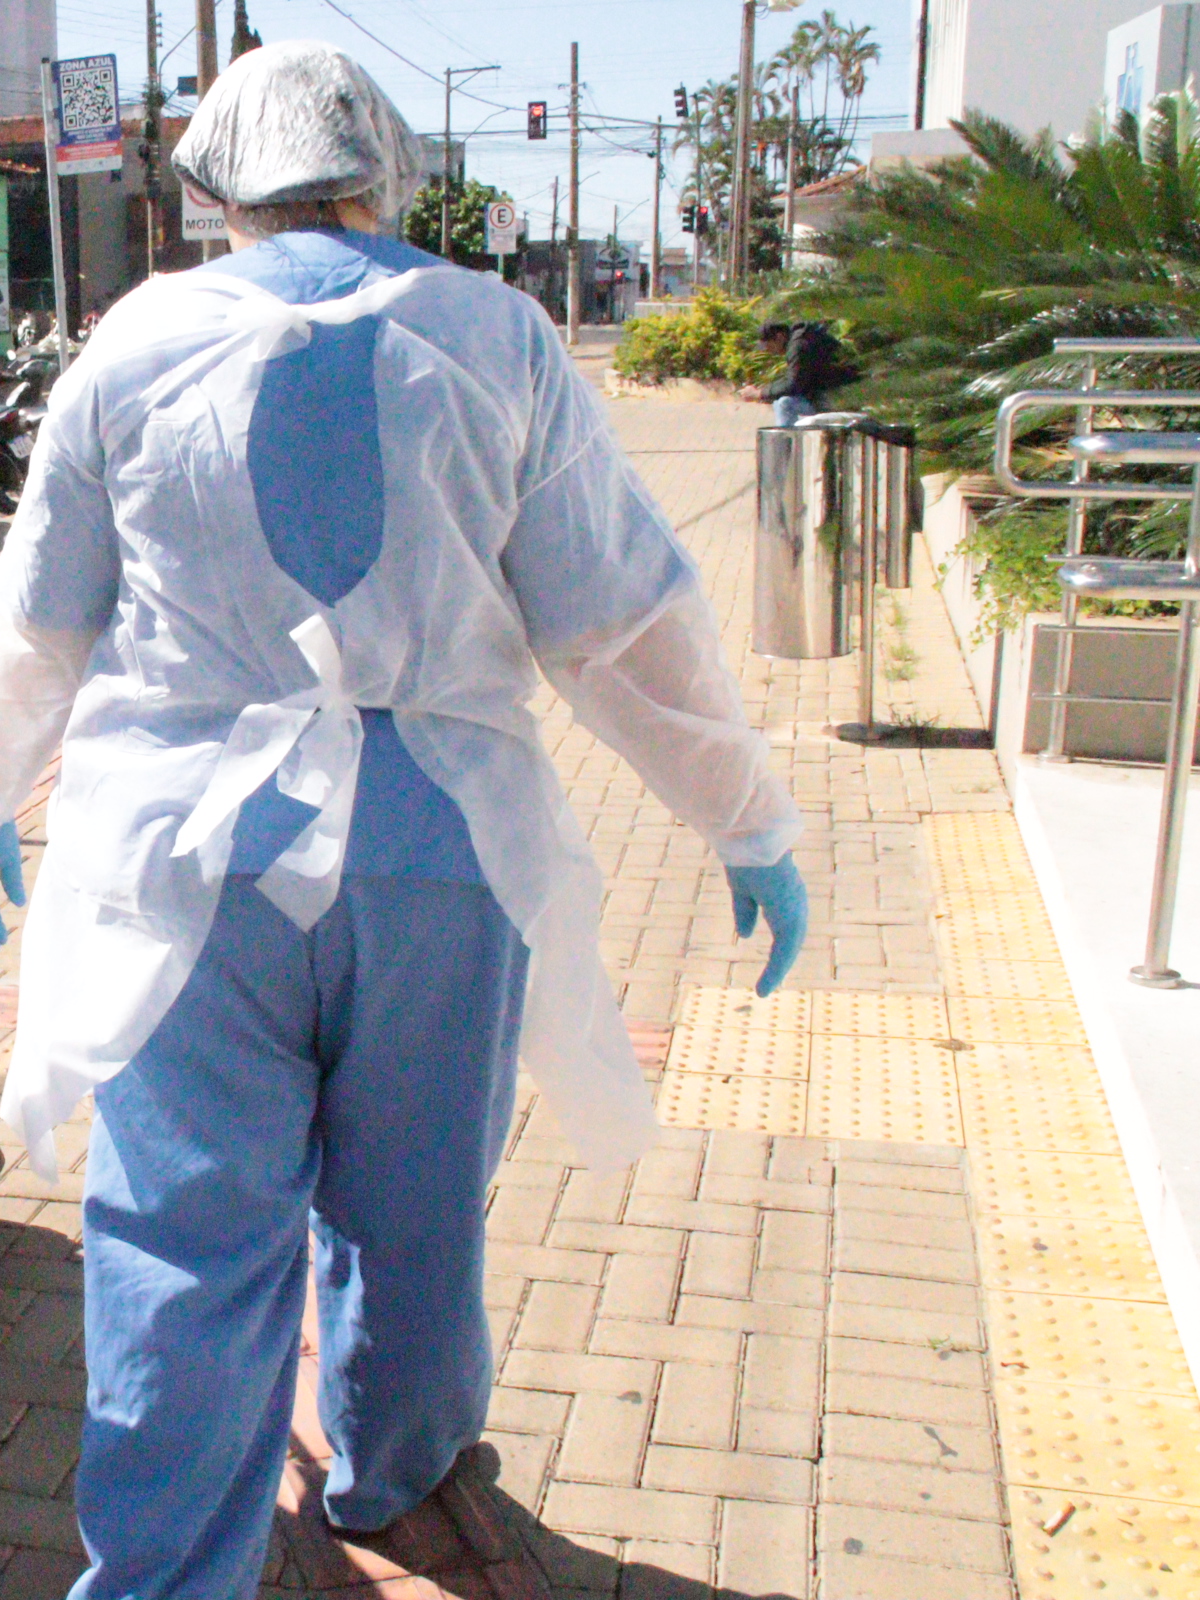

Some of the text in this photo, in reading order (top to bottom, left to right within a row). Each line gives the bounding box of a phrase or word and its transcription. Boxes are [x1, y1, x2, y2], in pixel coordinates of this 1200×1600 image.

[60, 57, 113, 72] ZONA AZUL
[497, 208, 507, 224] E
[185, 218, 225, 230] MOTO
